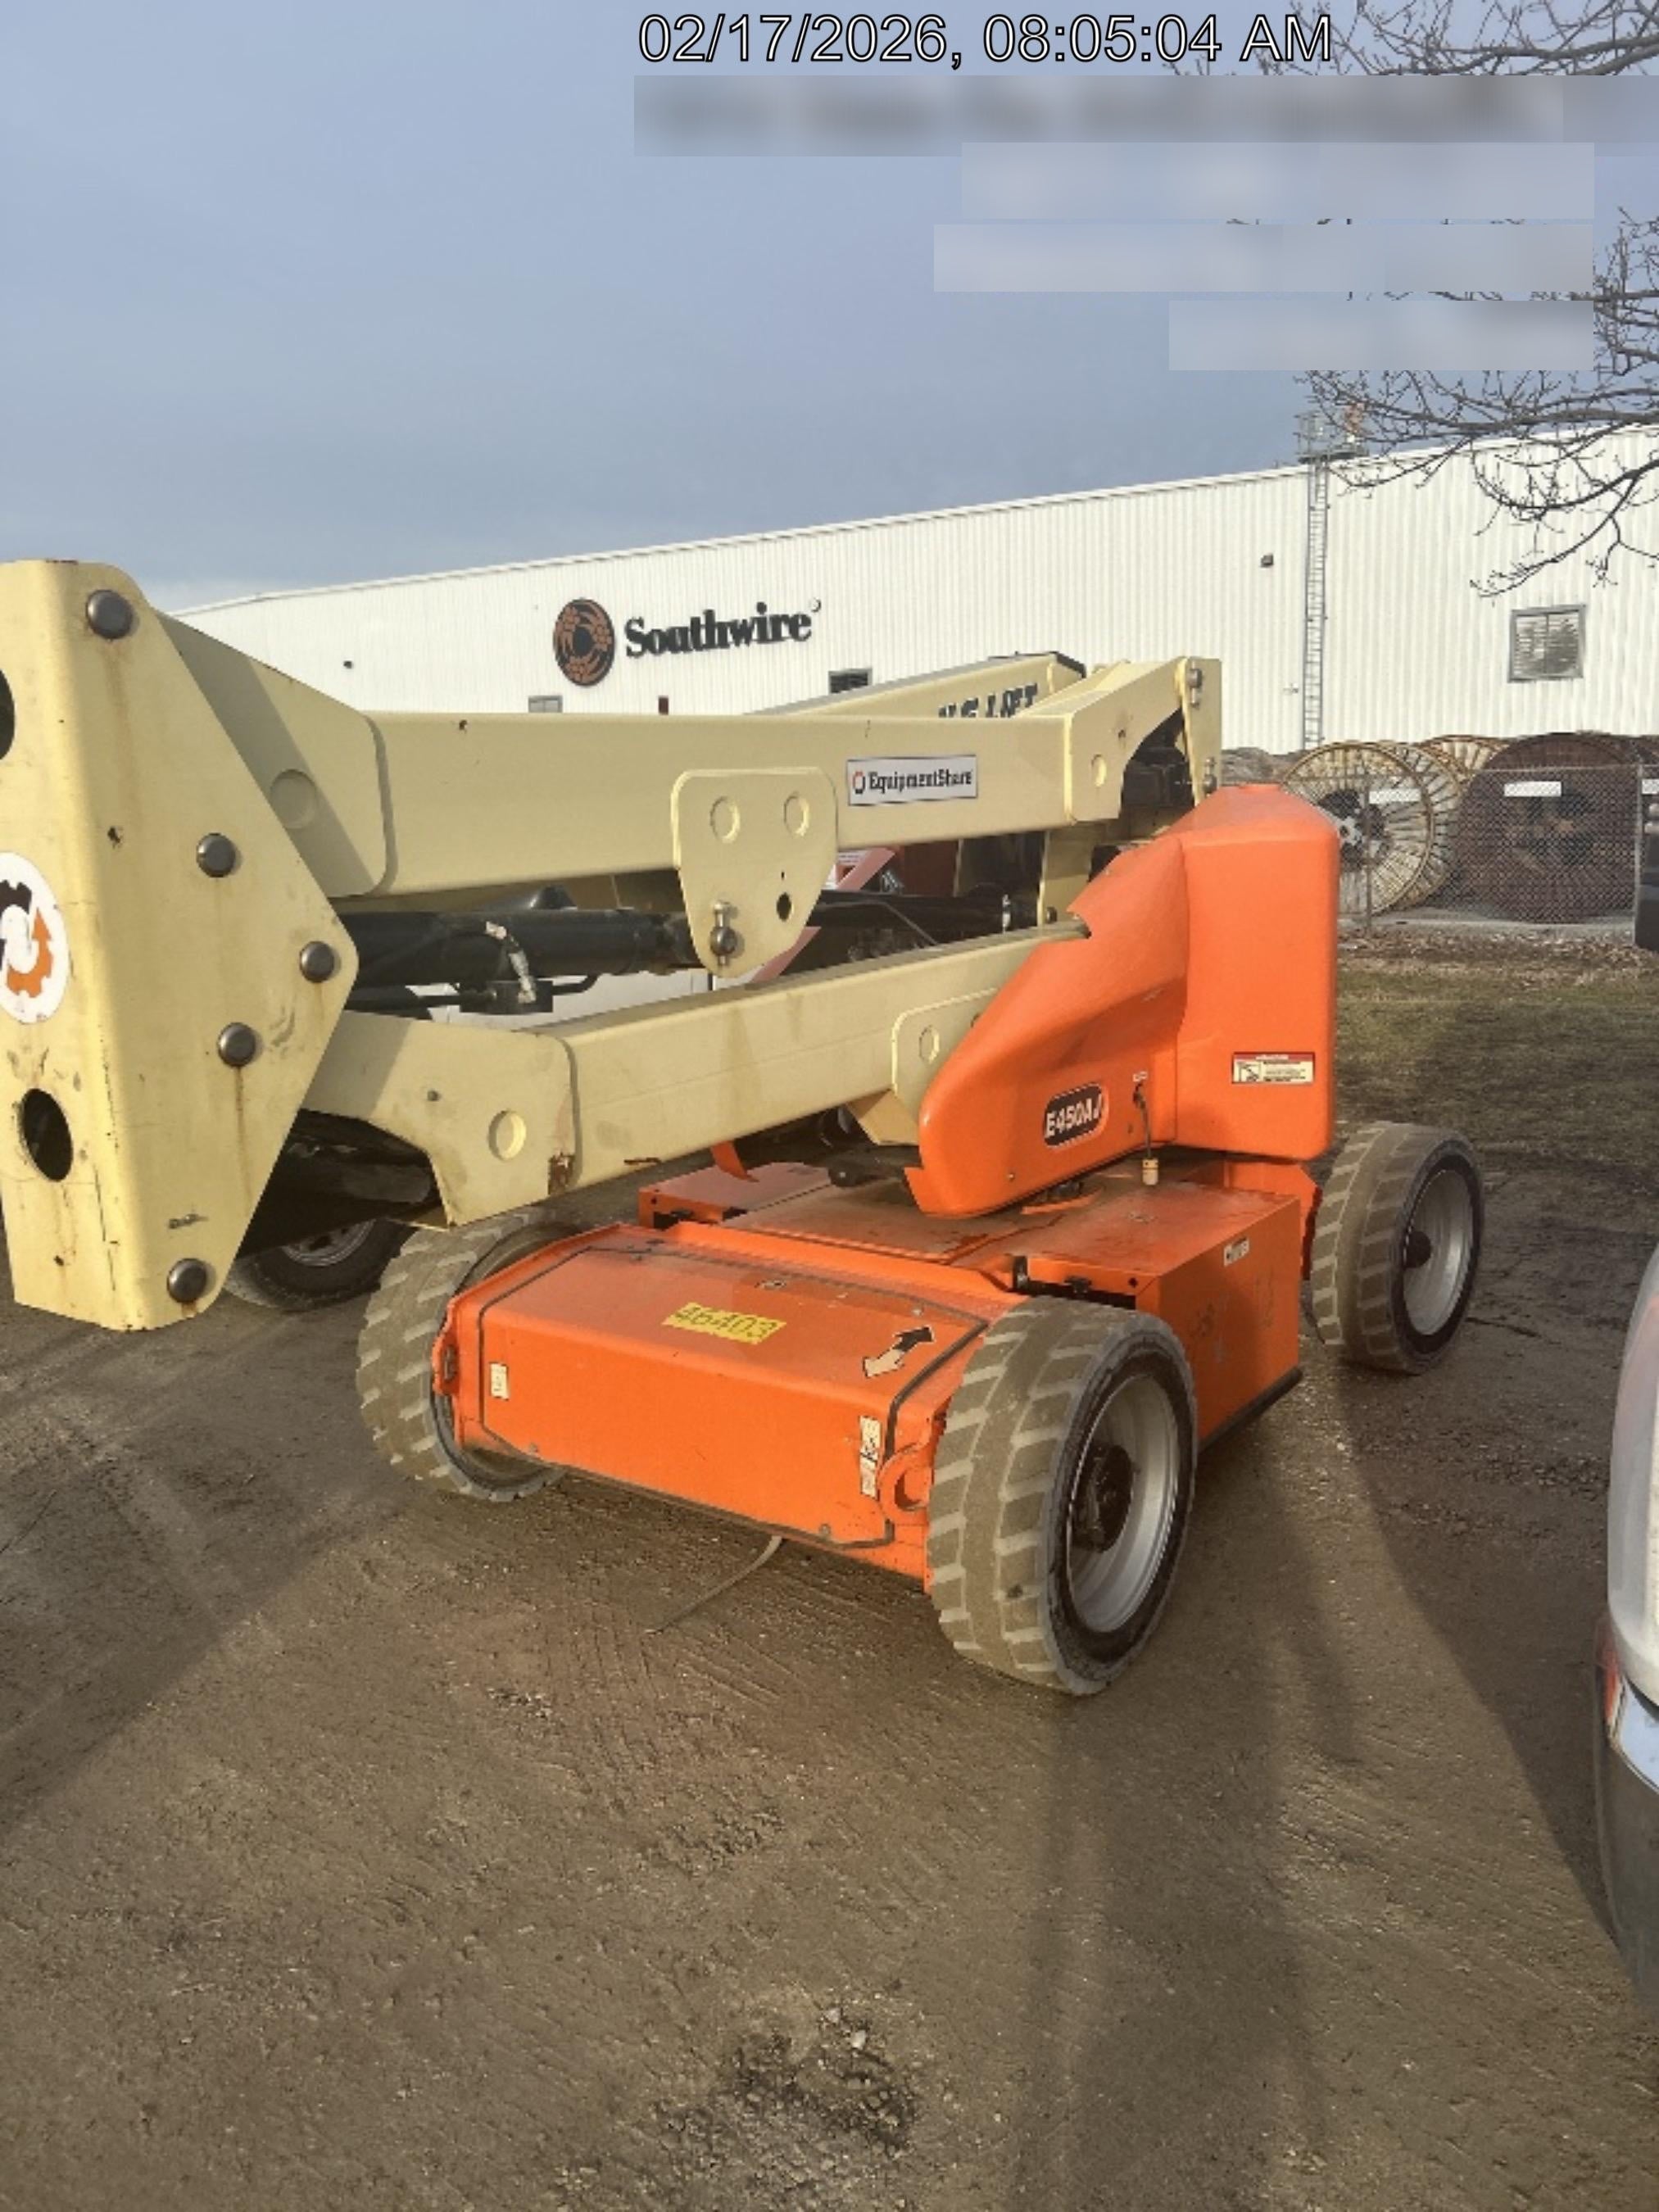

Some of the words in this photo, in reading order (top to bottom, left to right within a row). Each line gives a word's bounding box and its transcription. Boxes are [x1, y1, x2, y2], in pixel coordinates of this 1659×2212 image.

[625, 601, 812, 658] Southwire
[868, 768, 972, 794] EquipmentShare
[1045, 1094, 1103, 1138] E450AJ
